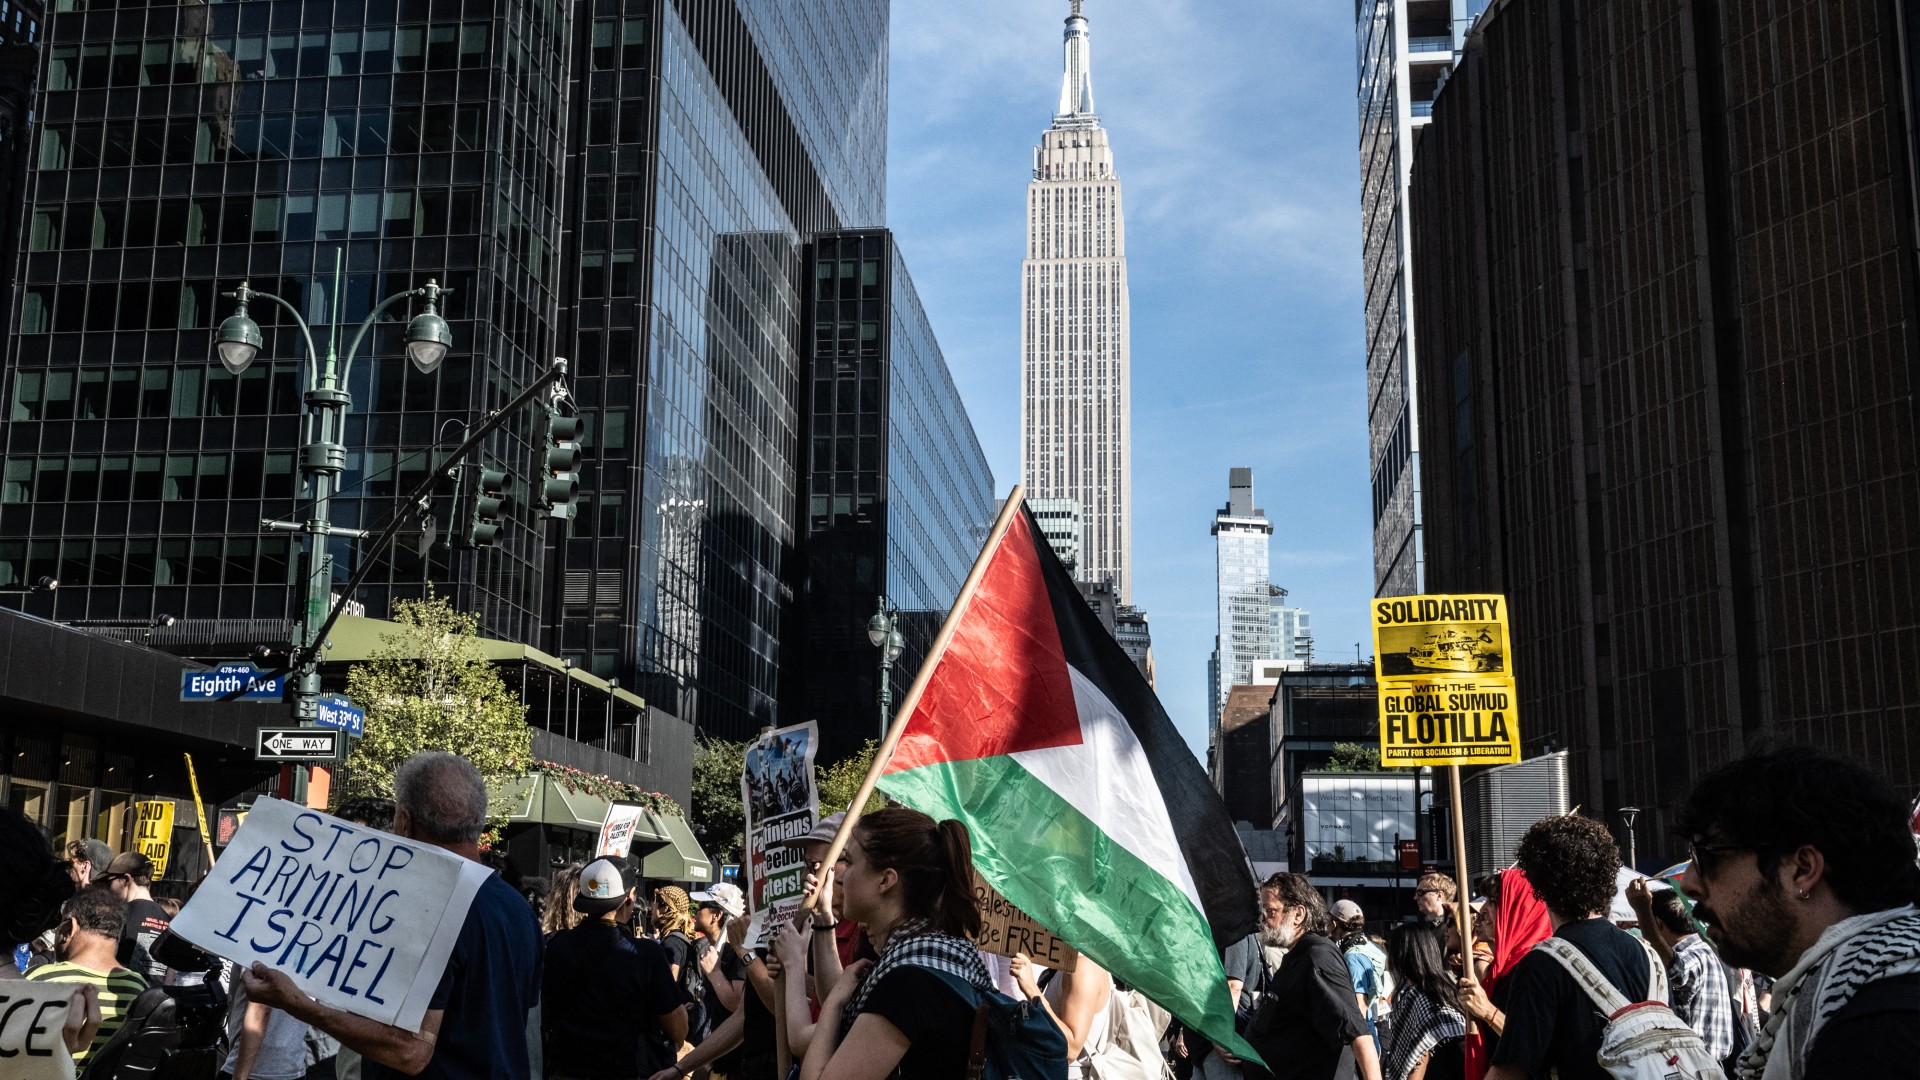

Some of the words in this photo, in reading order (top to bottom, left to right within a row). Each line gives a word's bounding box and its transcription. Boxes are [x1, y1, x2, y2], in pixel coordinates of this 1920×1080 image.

[1377, 599, 1498, 624] SOLIDARITY
[191, 675, 241, 697] Eighth
[245, 676, 276, 692] Ave
[1415, 684, 1448, 693] WITH
[1449, 683, 1476, 691] THE
[1384, 695, 1444, 713] GLOBAL
[1448, 693, 1509, 711] SUMUD
[319, 705, 338, 725] West
[338, 710, 352, 727] 33rd
[352, 714, 361, 730] St
[1386, 712, 1510, 745] FLOTILLA
[272, 739, 293, 749] ONE
[303, 739, 326, 749] WAY
[1388, 749, 1410, 757] PARTY
[1411, 749, 1424, 757] FOR
[1425, 748, 1462, 757] SOCIALISM
[1463, 748, 1469, 756] &
[1470, 747, 1510, 756] LIBERATION
[140, 802, 164, 821] END
[137, 821, 158, 839] ALL
[145, 843, 166, 858] AID
[280, 813, 414, 880] STOP
[229, 846, 400, 934] ARMING
[776, 911, 798, 922] SOCIA
[213, 891, 396, 1005] ISRAEL
[979, 922, 1000, 946] Be
[1005, 925, 1063, 963] FREE
